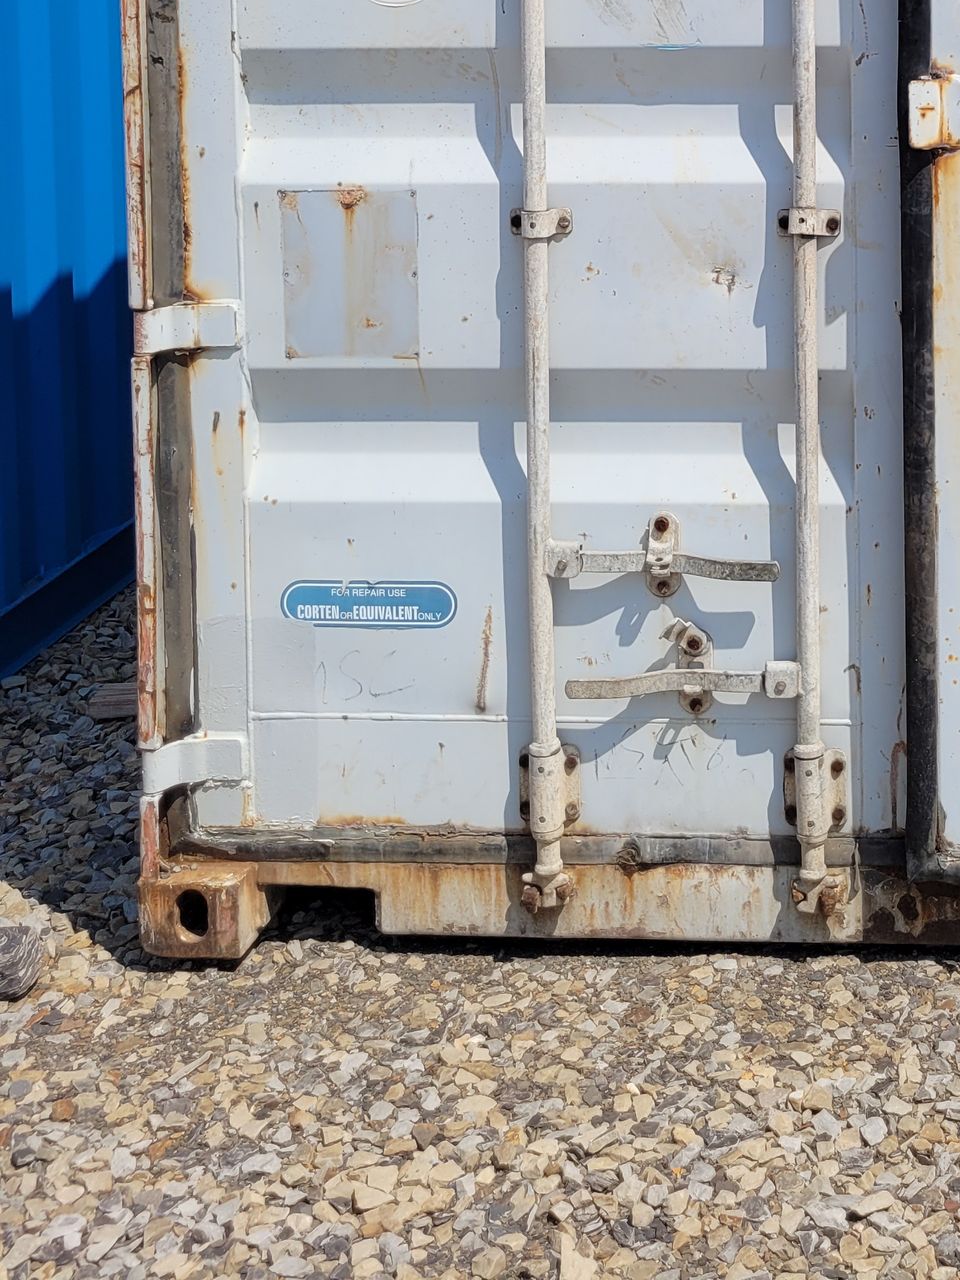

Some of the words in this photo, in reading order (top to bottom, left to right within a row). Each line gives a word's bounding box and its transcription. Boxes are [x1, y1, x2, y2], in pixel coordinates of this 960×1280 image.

[331, 588, 350, 597] FOR
[352, 588, 386, 597] REPAIR
[387, 588, 407, 597] USE
[297, 604, 340, 620] CORTEN
[353, 605, 419, 621] EQUIVALENT
[417, 612, 442, 621] ONLY
